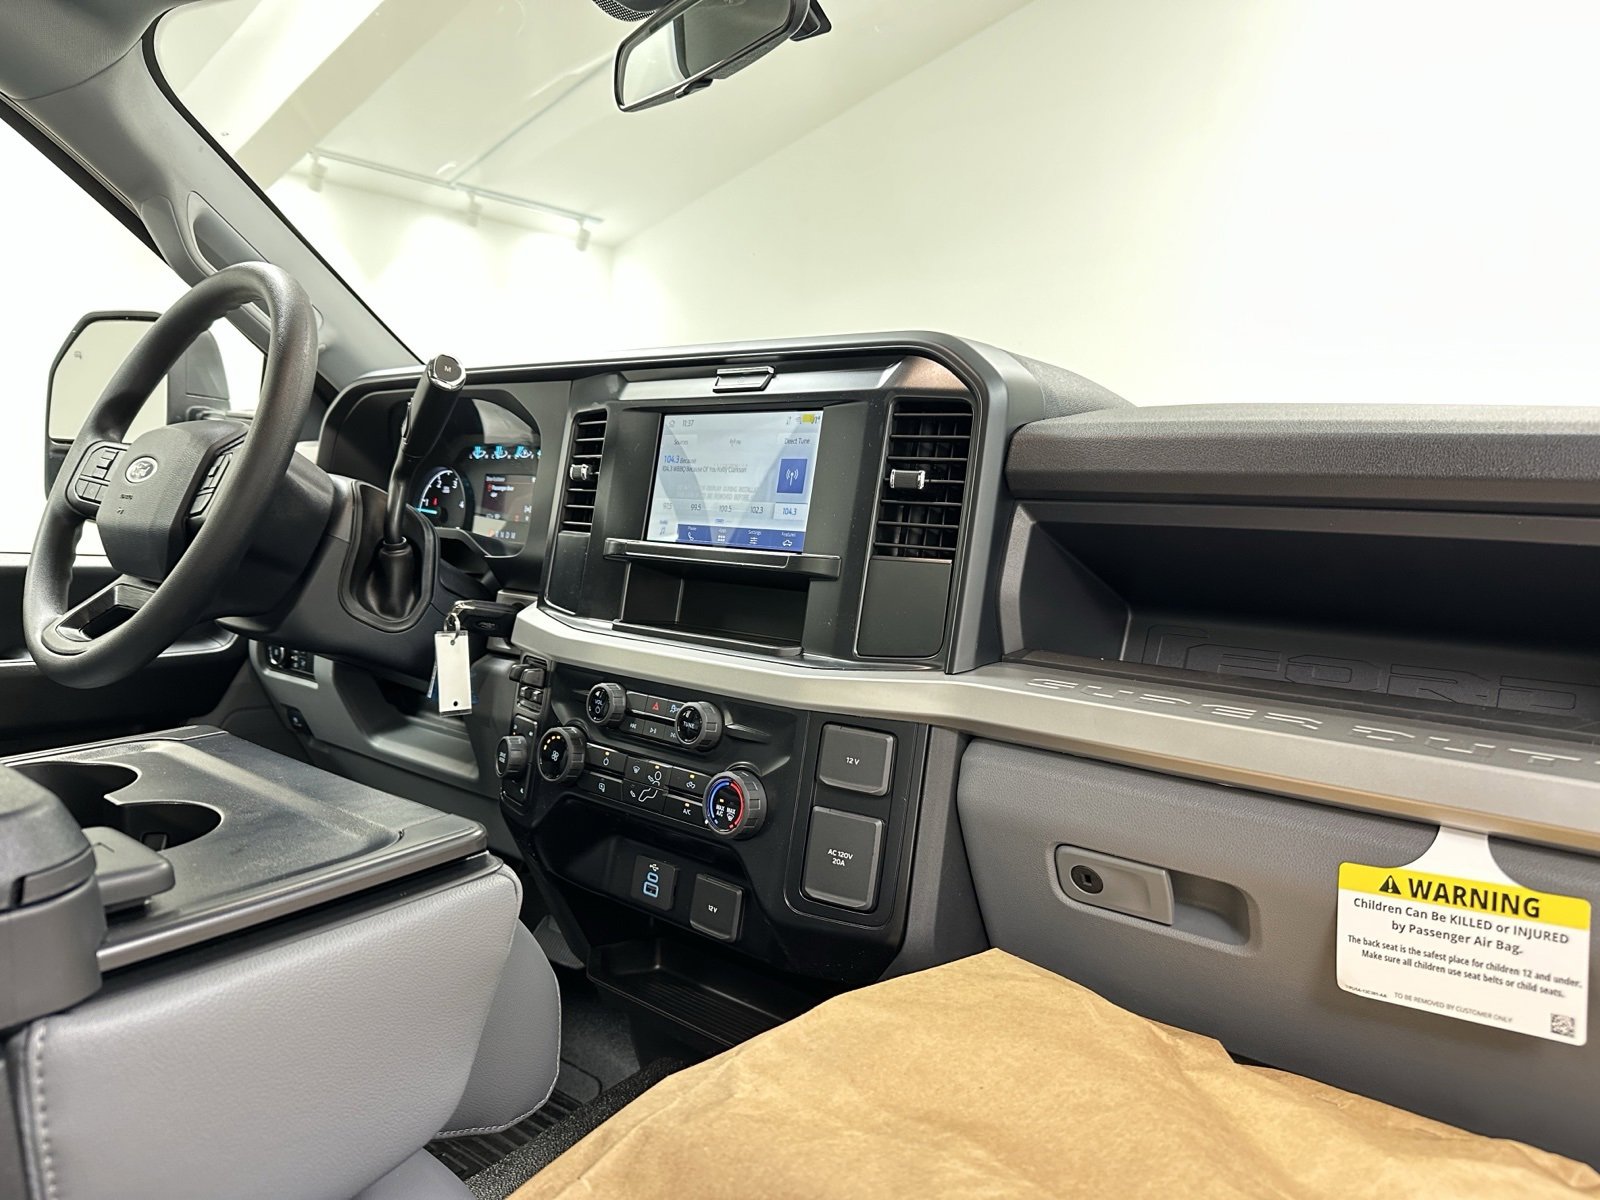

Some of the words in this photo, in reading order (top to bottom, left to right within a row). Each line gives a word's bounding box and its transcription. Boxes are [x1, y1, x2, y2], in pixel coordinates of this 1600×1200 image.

[798, 437, 811, 445] Tune
[664, 455, 680, 464] 104.3
[690, 503, 702, 511] 99.5
[750, 506, 764, 514] 102.3
[782, 507, 797, 515] 104.3
[683, 720, 695, 729] TUNE
[1026, 677, 1324, 731] SUPER
[1351, 724, 1600, 769] DUT
[682, 808, 691, 816] A/C
[827, 848, 837, 857] AC
[838, 850, 853, 860] 120V
[832, 857, 846, 867] 20A
[1408, 877, 1540, 918] WARNING
[1353, 897, 1402, 915] Children
[1405, 906, 1428, 920] Can
[1431, 911, 1447, 923] Be
[1450, 914, 1493, 931] KILLED
[1496, 924, 1510, 934] or
[1513, 925, 1570, 944] INJURED
[1391, 920, 1406, 934] by
[1409, 924, 1472, 945] Passenger
[1473, 936, 1492, 949] Air
[1496, 939, 1523, 956] Bag.
[1347, 934, 1361, 945] The
[1362, 937, 1380, 949] back
[1382, 942, 1398, 952] seat
[1399, 944, 1407, 953] is
[1408, 946, 1421, 956] the
[1423, 950, 1447, 962] safest
[1448, 954, 1470, 966] place
[1471, 958, 1483, 969] for
[1485, 961, 1520, 976] children
[1522, 968, 1532, 978] 12
[1534, 972, 1551, 982] and
[1553, 976, 1582, 988] under.
[1361, 949, 1382, 961] Make
[1384, 954, 1401, 965] sure
[1402, 958, 1412, 967] all
[1413, 960, 1446, 973] children
[1447, 967, 1462, 977] use
[1463, 970, 1481, 981] seat
[1483, 973, 1503, 986] belts
[1516, 981, 1537, 993] child
[1539, 985, 1565, 998] seats.
[1394, 991, 1404, 1000] TO
[1404, 994, 1413, 1002] BE
[1413, 996, 1445, 1009] REMOVED
[1446, 1003, 1455, 1011] BY
[1455, 1006, 1492, 1019] CUSTOMER
[1493, 1014, 1513, 1023] ONLY
